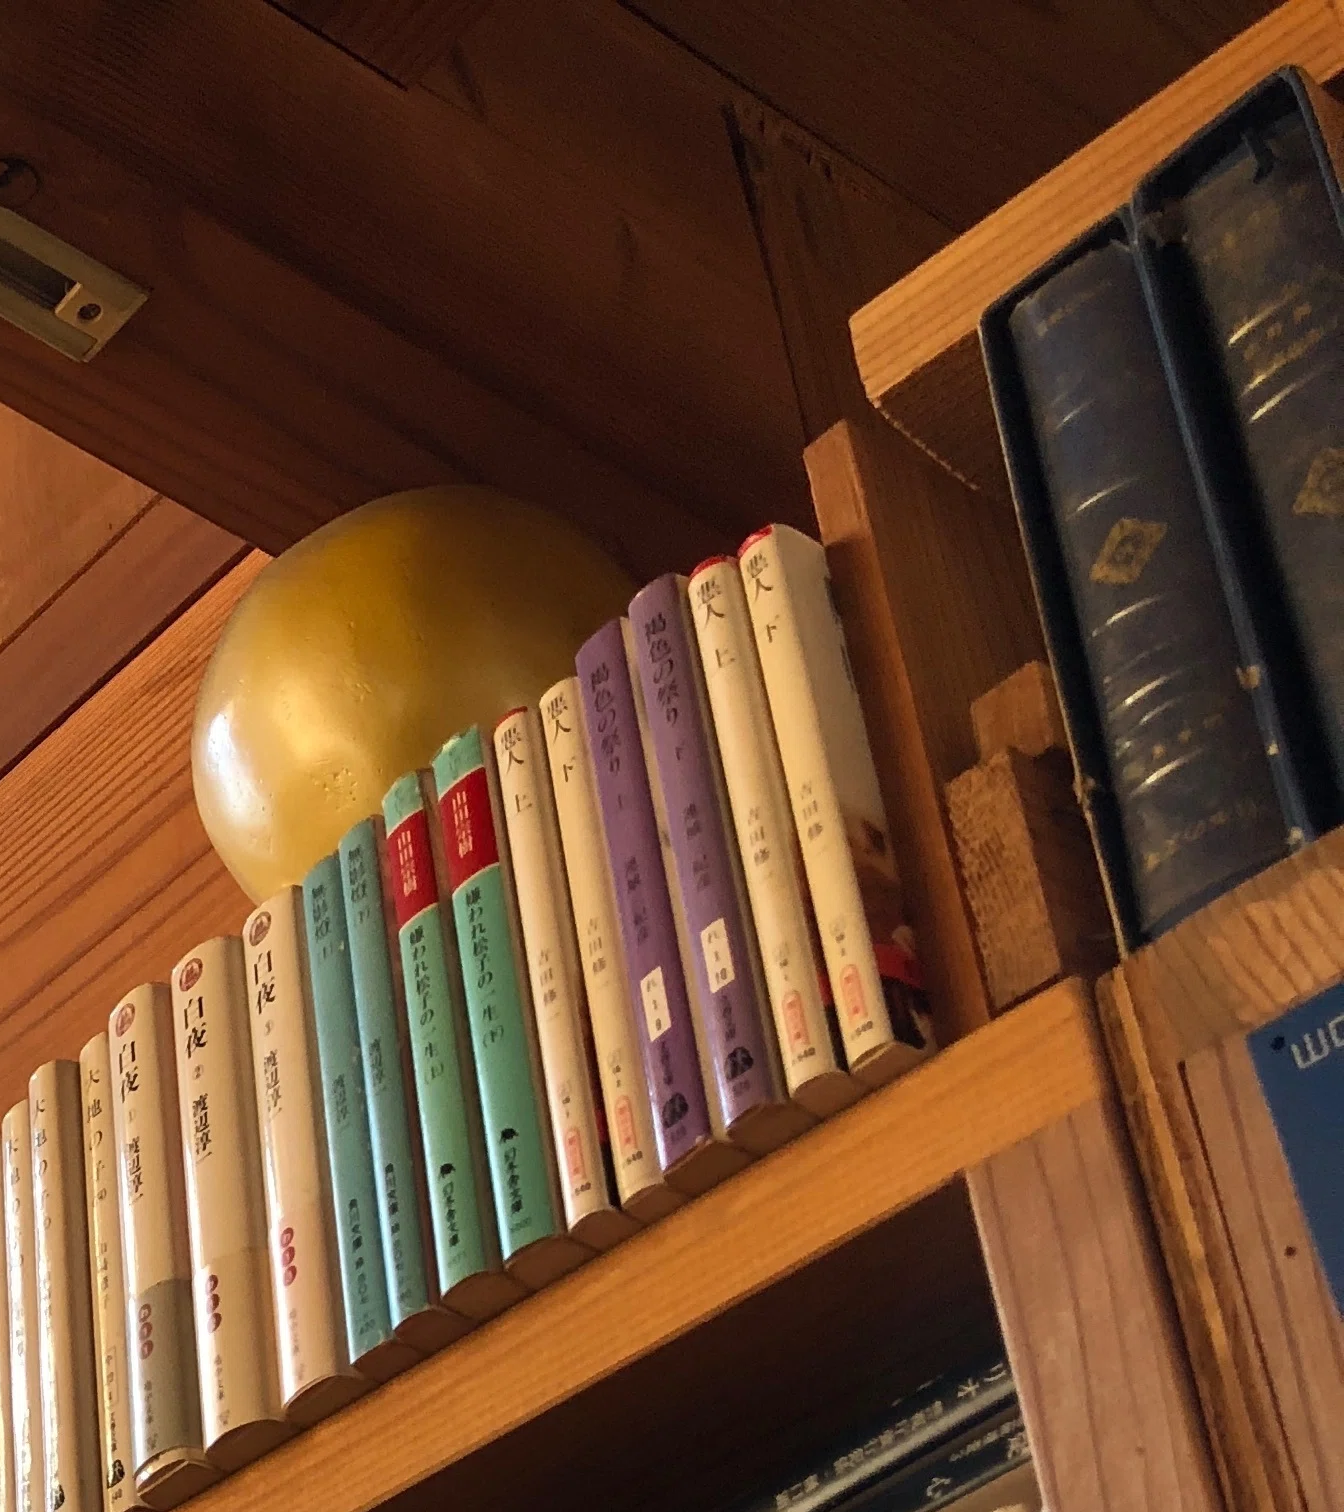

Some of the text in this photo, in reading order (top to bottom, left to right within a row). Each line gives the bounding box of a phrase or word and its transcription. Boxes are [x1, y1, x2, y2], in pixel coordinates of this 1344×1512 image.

[746, 551, 773, 602] 悪人
[697, 580, 725, 629] 悪人
[547, 693, 572, 743] 悪人
[500, 726, 526, 774] 悪人
[254, 950, 277, 1016] 白夜
[183, 995, 208, 1061] 白夜
[118, 1040, 141, 1104] 白夜
